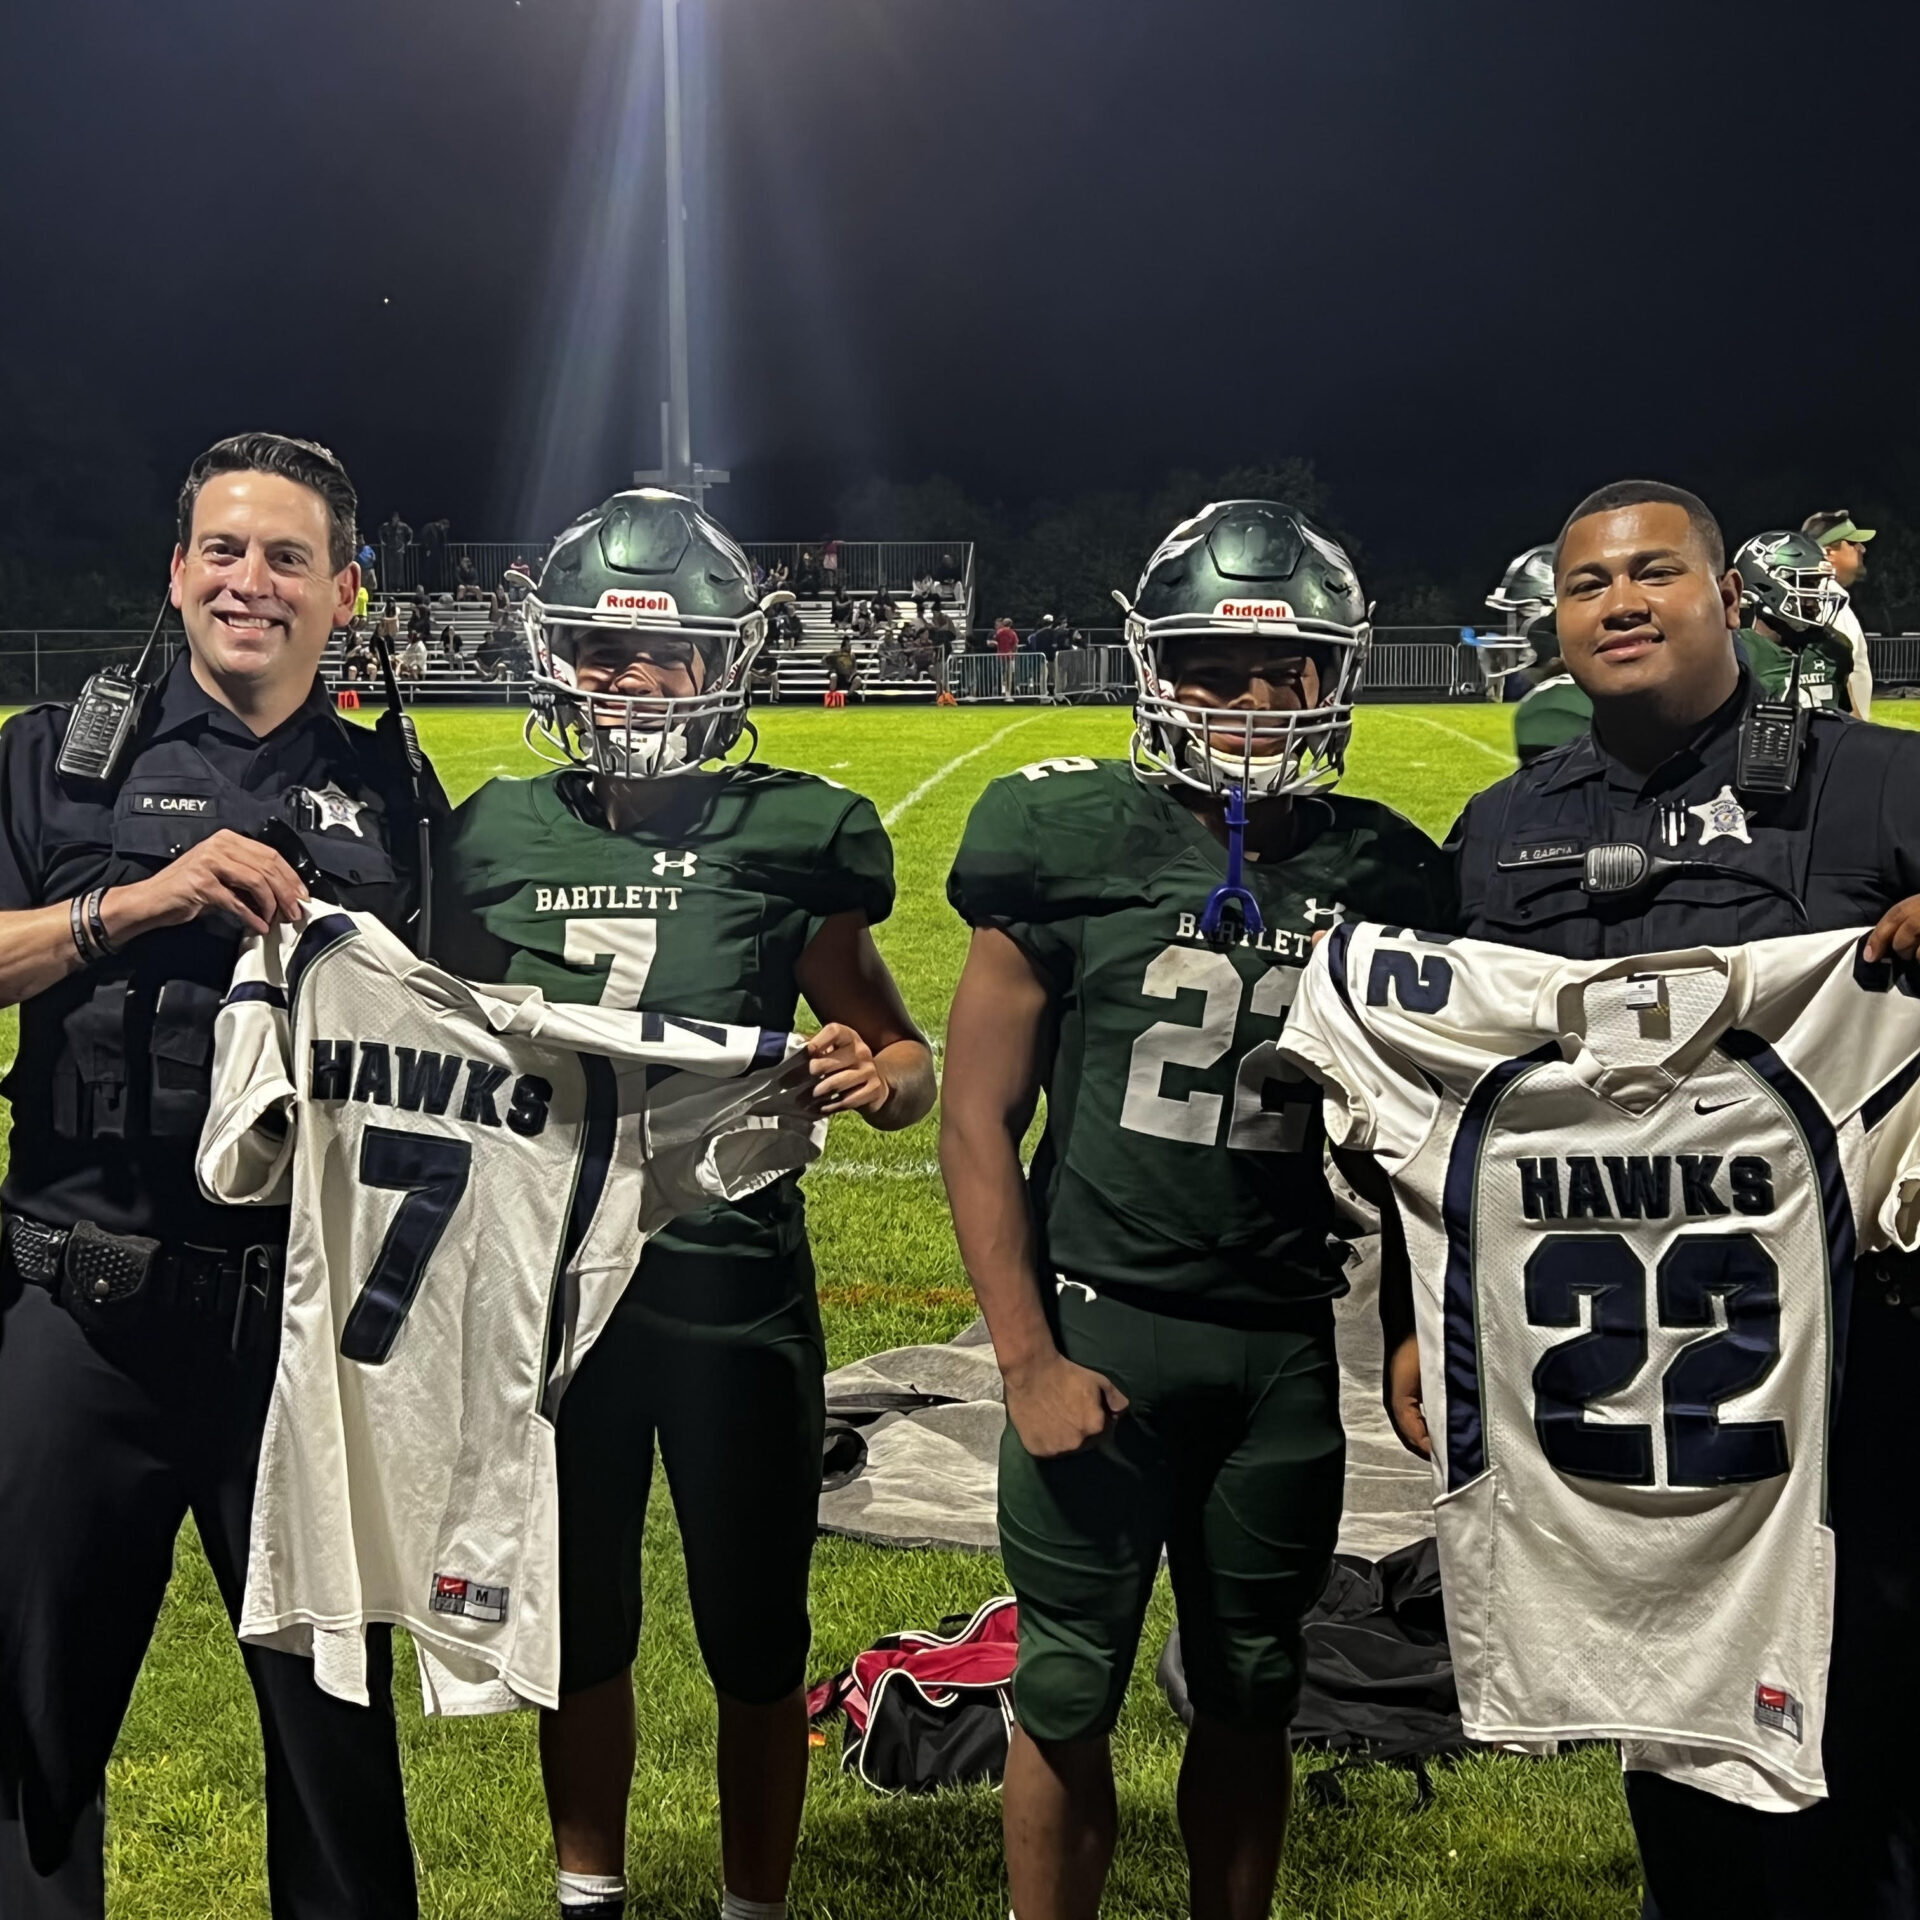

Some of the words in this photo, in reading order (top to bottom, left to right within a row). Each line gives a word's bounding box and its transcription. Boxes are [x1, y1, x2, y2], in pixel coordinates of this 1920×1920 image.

[606, 595, 668, 611] Riddell
[1222, 603, 1286, 618] Riddell
[160, 798, 207, 812] CAREY
[535, 886, 683, 912] BARTLETT
[563, 918, 657, 1009] 7
[1120, 944, 1312, 1153] 22
[310, 1039, 554, 1138] HAWKS
[1516, 1155, 1775, 1220] HAWKS
[340, 1123, 473, 1366] 7
[1524, 1233, 1790, 1487] 22
[475, 1589, 489, 1605] M
